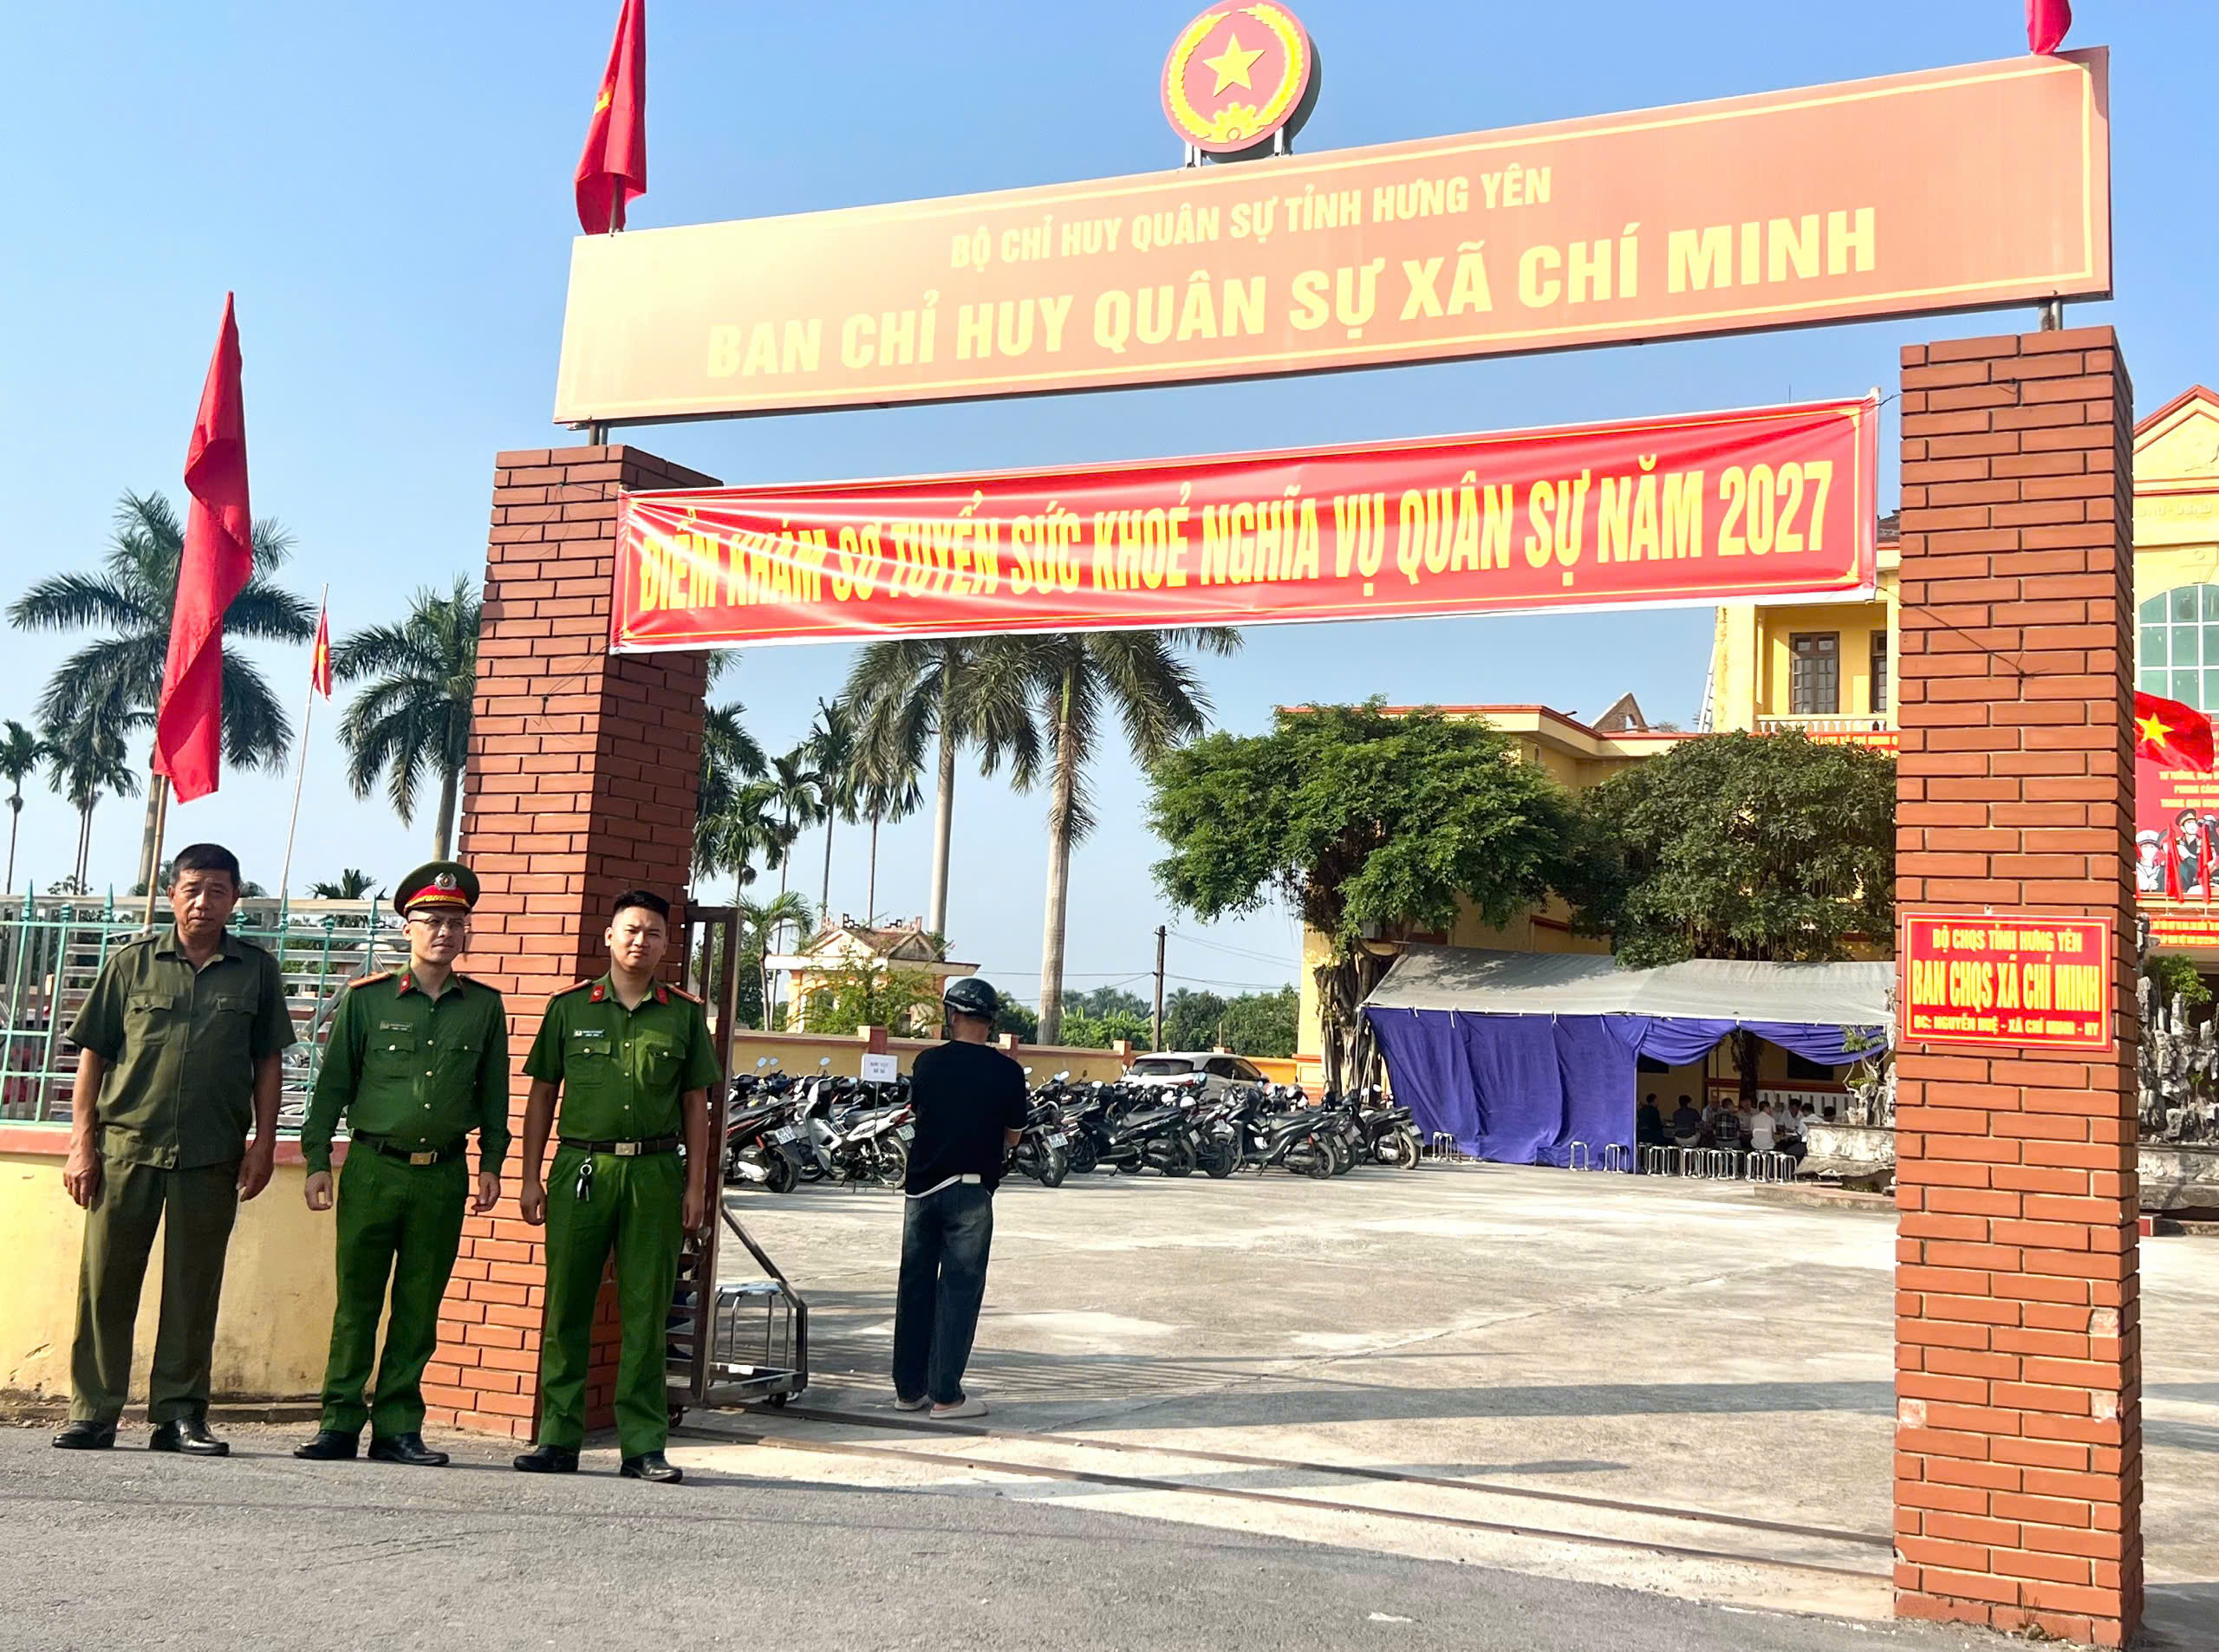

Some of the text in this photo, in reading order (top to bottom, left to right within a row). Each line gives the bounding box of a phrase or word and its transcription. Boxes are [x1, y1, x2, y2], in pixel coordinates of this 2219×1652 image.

[950, 163, 1552, 272] BỘ CHỈ HUY QUÂN SỰ TỈNH HƯNG YÊN
[706, 207, 1875, 378] BAN CHỈ HUY QUÂN SỰ XÃ CHÍ MINH
[639, 453, 1833, 612] ĐIỂM KHÁM SƠ TUYỂN SỨC KHOẺ NGHĨA VỤ QUÂN SỰ NĂM 2027
[1911, 953, 2100, 1012] BAN CHQS XÃ CHÍ MINH
[1932, 923, 2083, 953] BỘ CHQS TỈNH HƯNG YÊN
